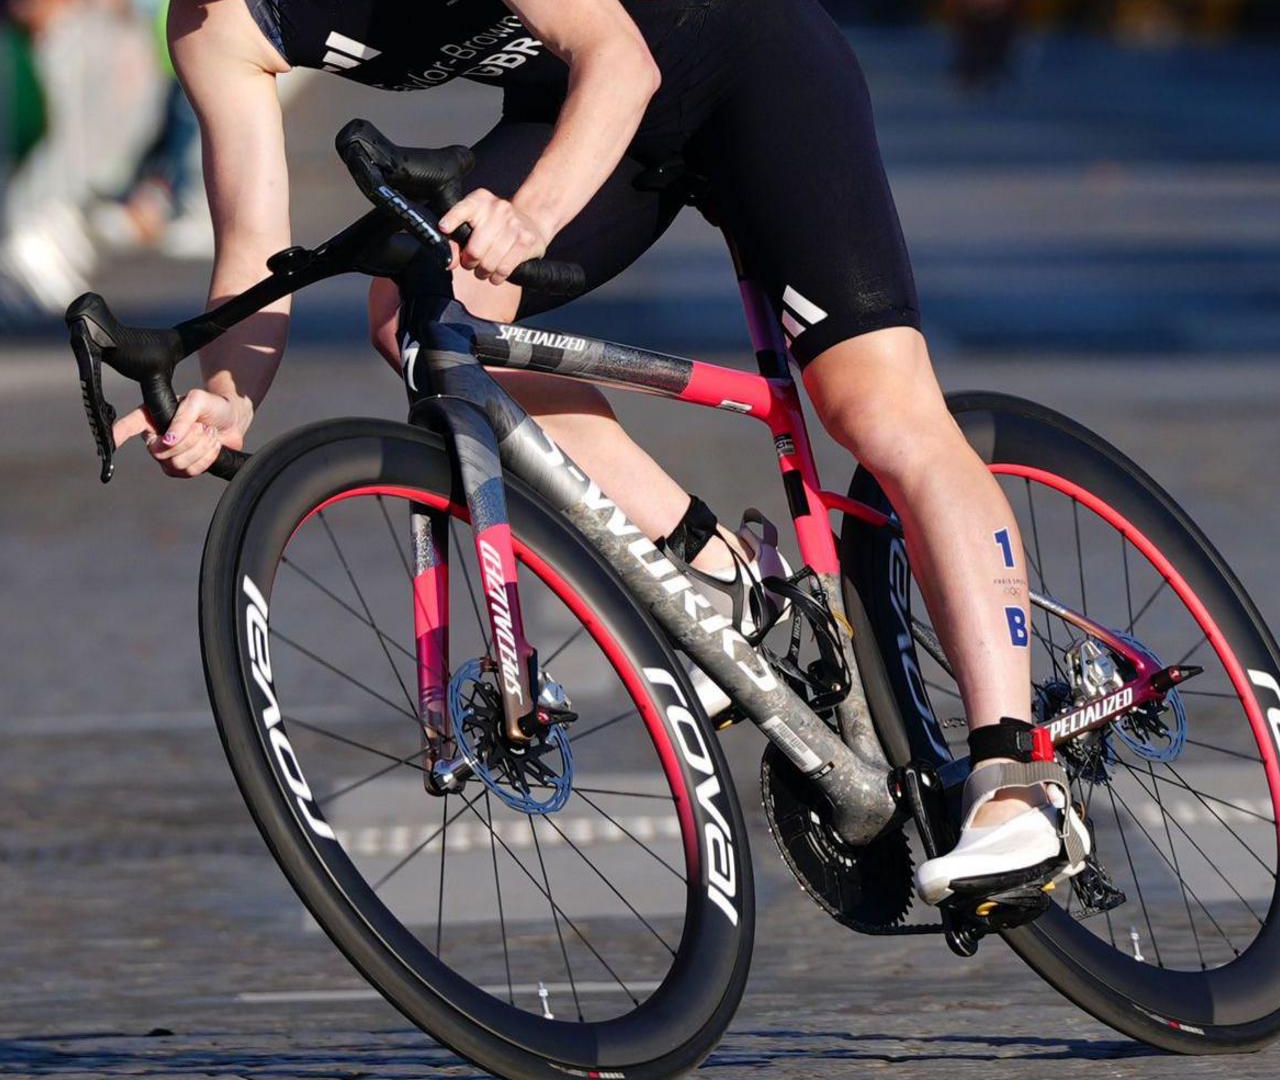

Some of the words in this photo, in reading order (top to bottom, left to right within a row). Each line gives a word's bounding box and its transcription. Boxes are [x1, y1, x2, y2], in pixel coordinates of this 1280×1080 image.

[464, 37, 543, 77] GBR
[495, 324, 586, 351] SPECIALIZED
[994, 528, 1015, 567] 1
[480, 539, 523, 706] SPECIALIZED
[1005, 607, 1028, 647] B
[243, 574, 336, 841] roval
[1045, 687, 1133, 742] PECIALIZED
[643, 667, 738, 927] roval
